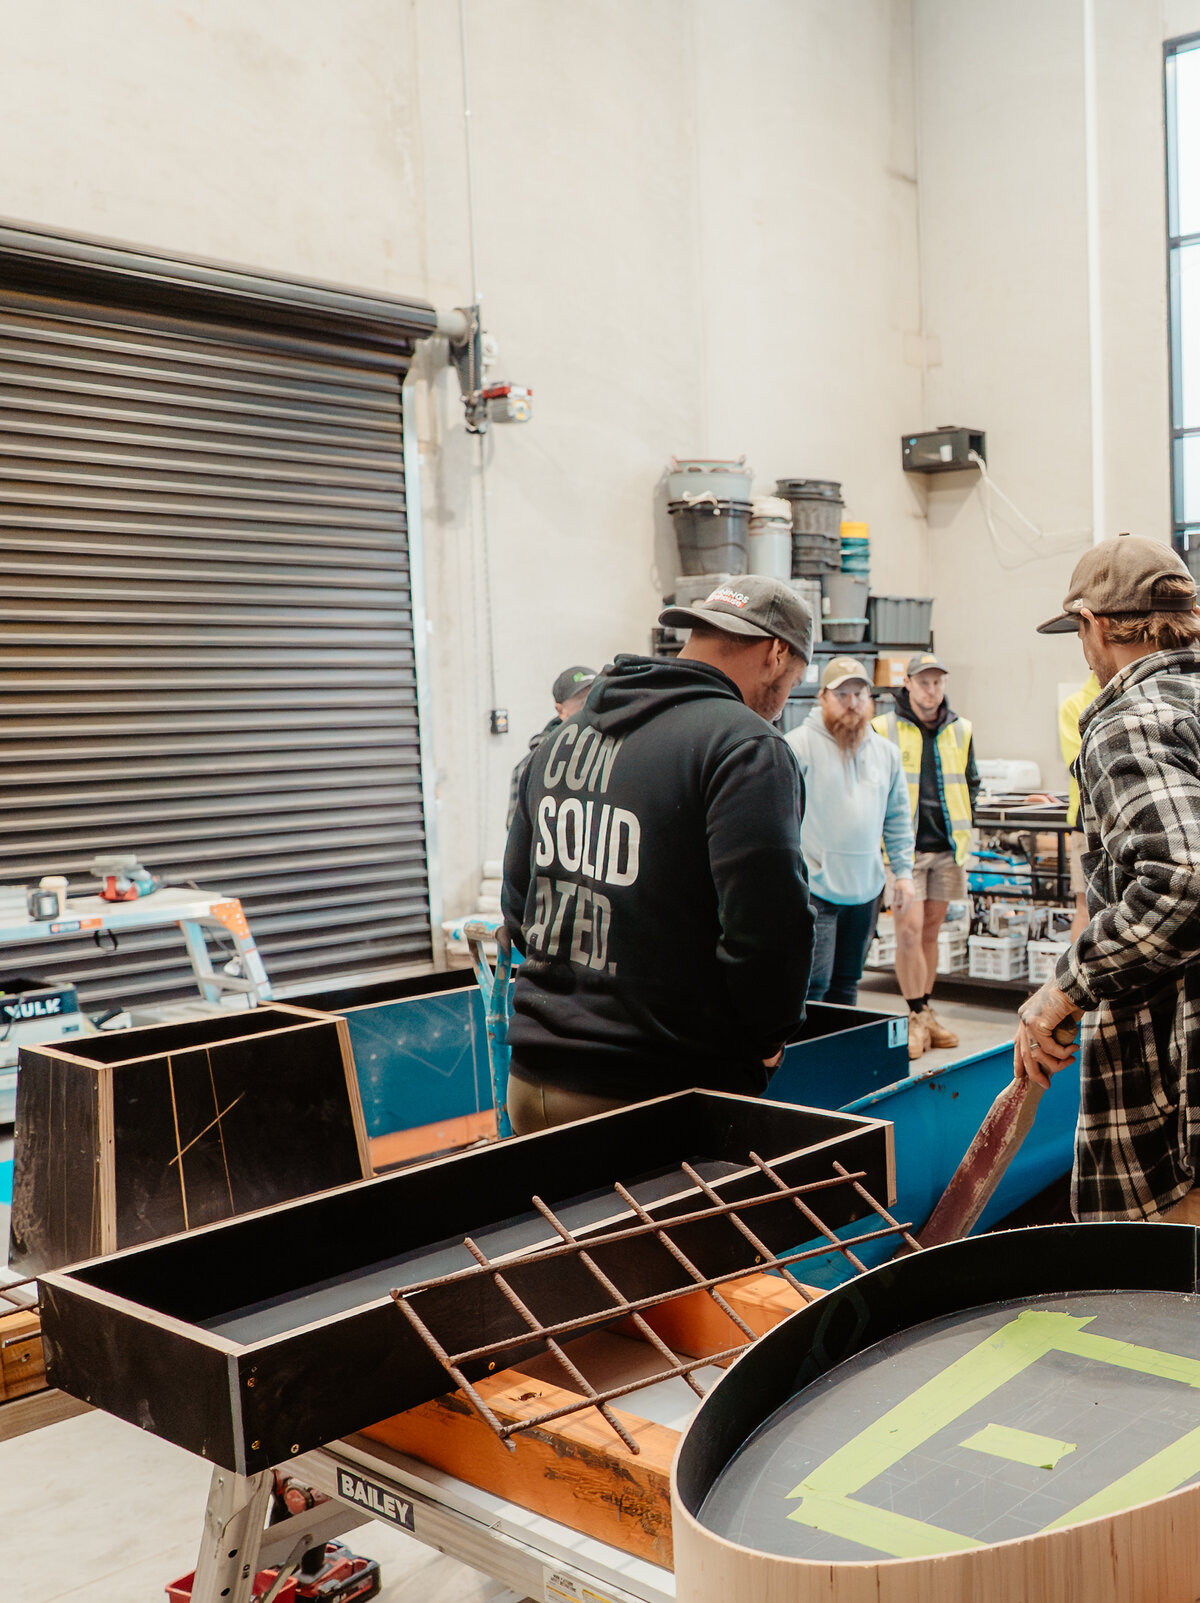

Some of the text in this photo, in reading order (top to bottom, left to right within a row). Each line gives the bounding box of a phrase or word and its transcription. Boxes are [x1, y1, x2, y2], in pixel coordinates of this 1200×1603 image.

[543, 723, 624, 794] CON
[536, 795, 641, 887] SOLID
[525, 875, 618, 977] ATED.
[340, 1472, 410, 1525] BAILEY
